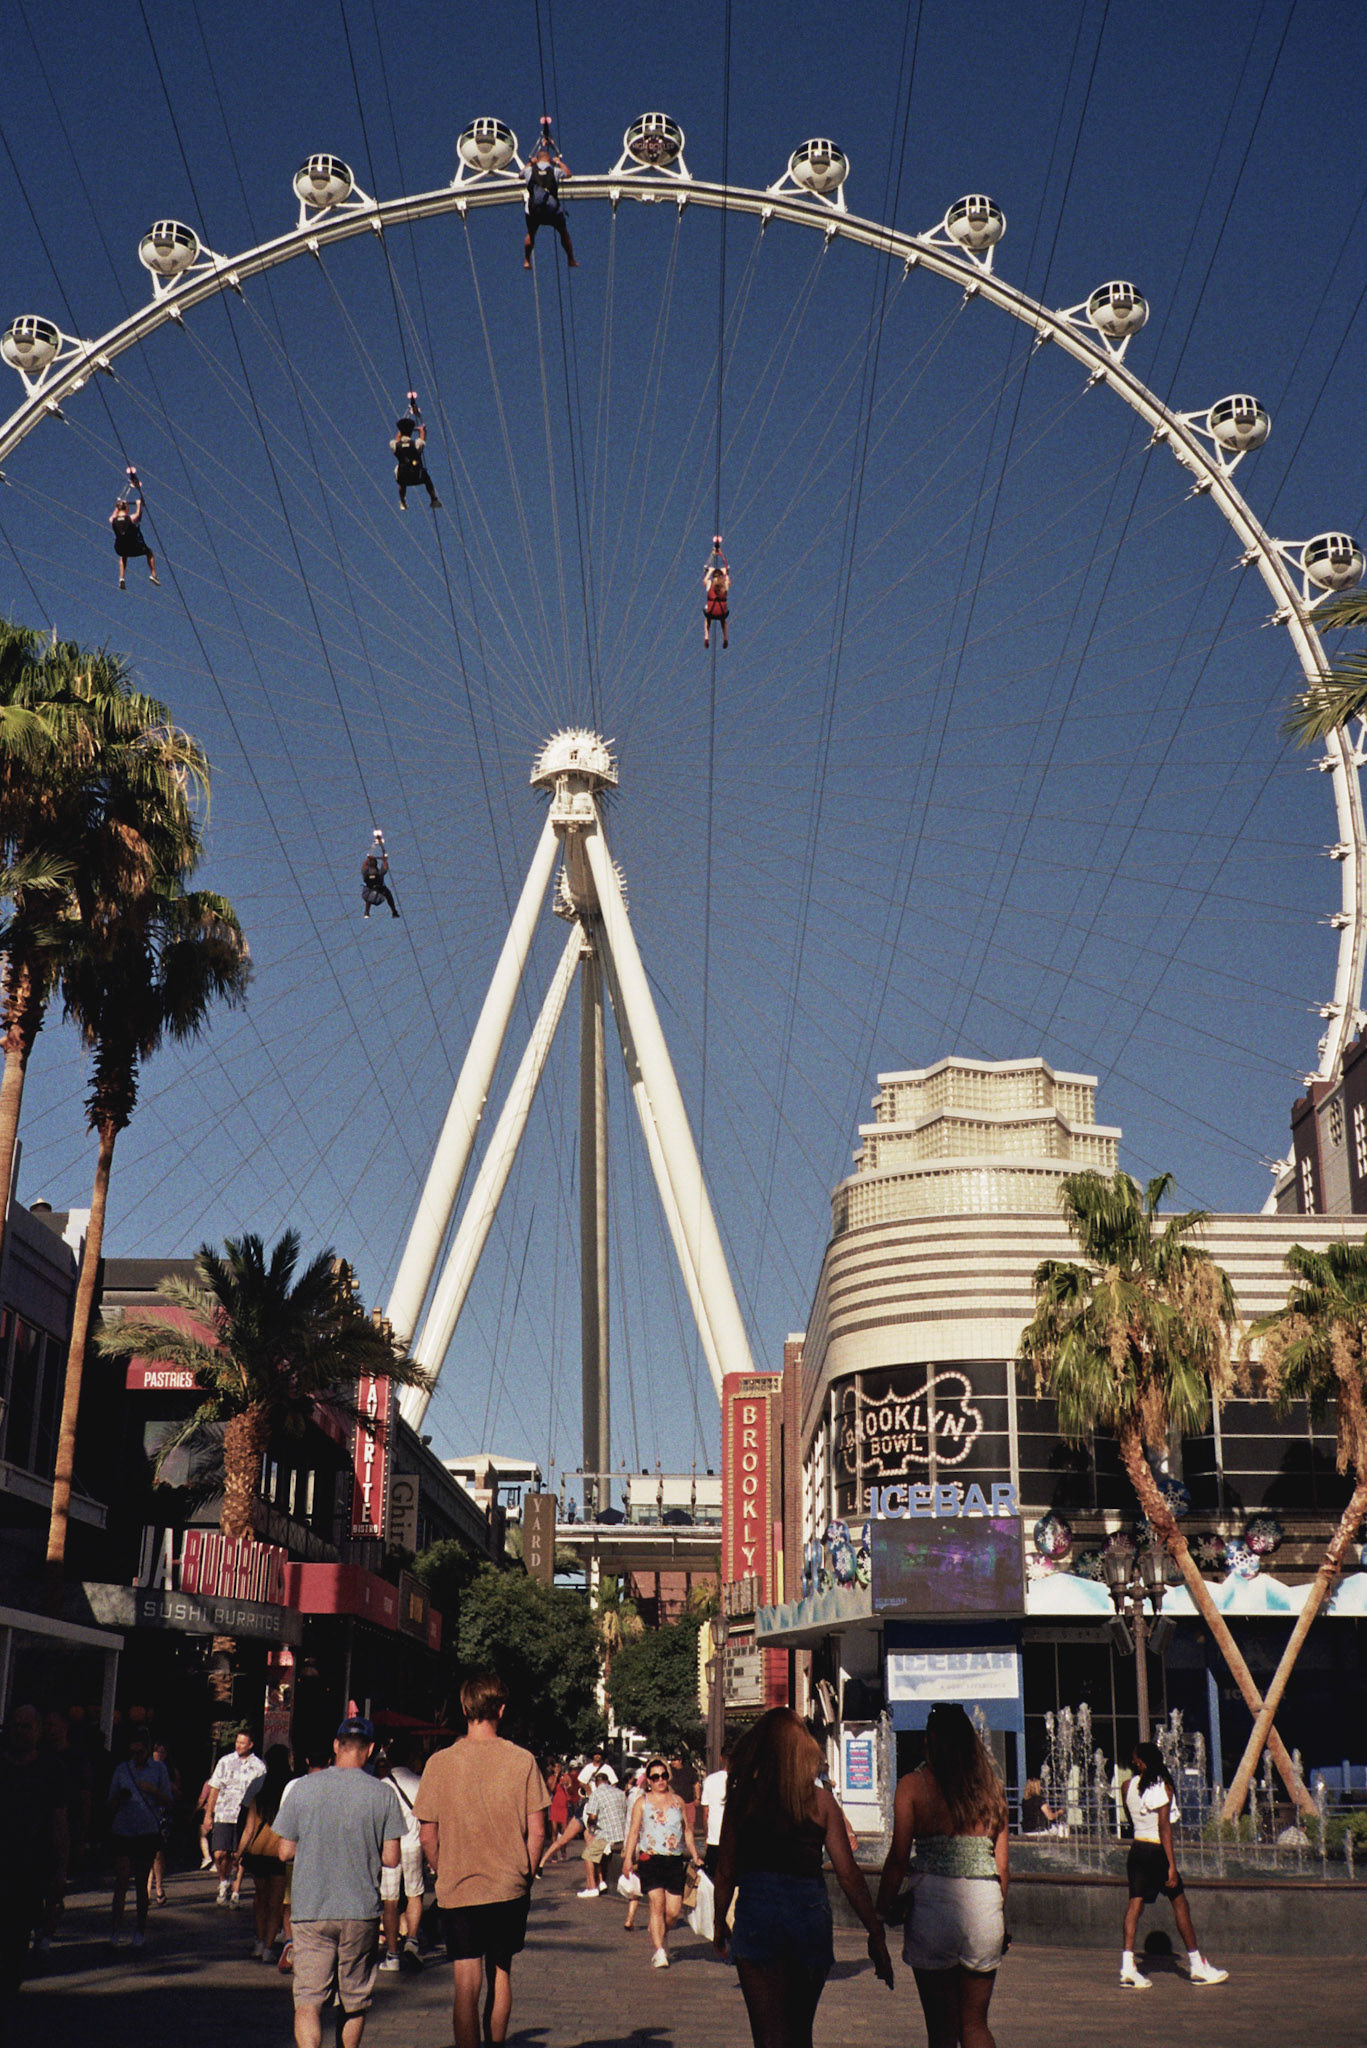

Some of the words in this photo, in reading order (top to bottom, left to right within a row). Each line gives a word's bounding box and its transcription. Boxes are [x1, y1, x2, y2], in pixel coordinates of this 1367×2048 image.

[143, 1371, 193, 1388] PASTRIES
[870, 1433, 923, 1455] BOWL
[870, 1483, 1020, 1519] ICEBAR
[352, 1524, 378, 1534] BISTRO
[531, 1498, 542, 1567] YARD
[143, 1601, 207, 1622] SUSHI
[214, 1608, 281, 1631] BURRITOS
[894, 1653, 1013, 1672] ICEBAR
